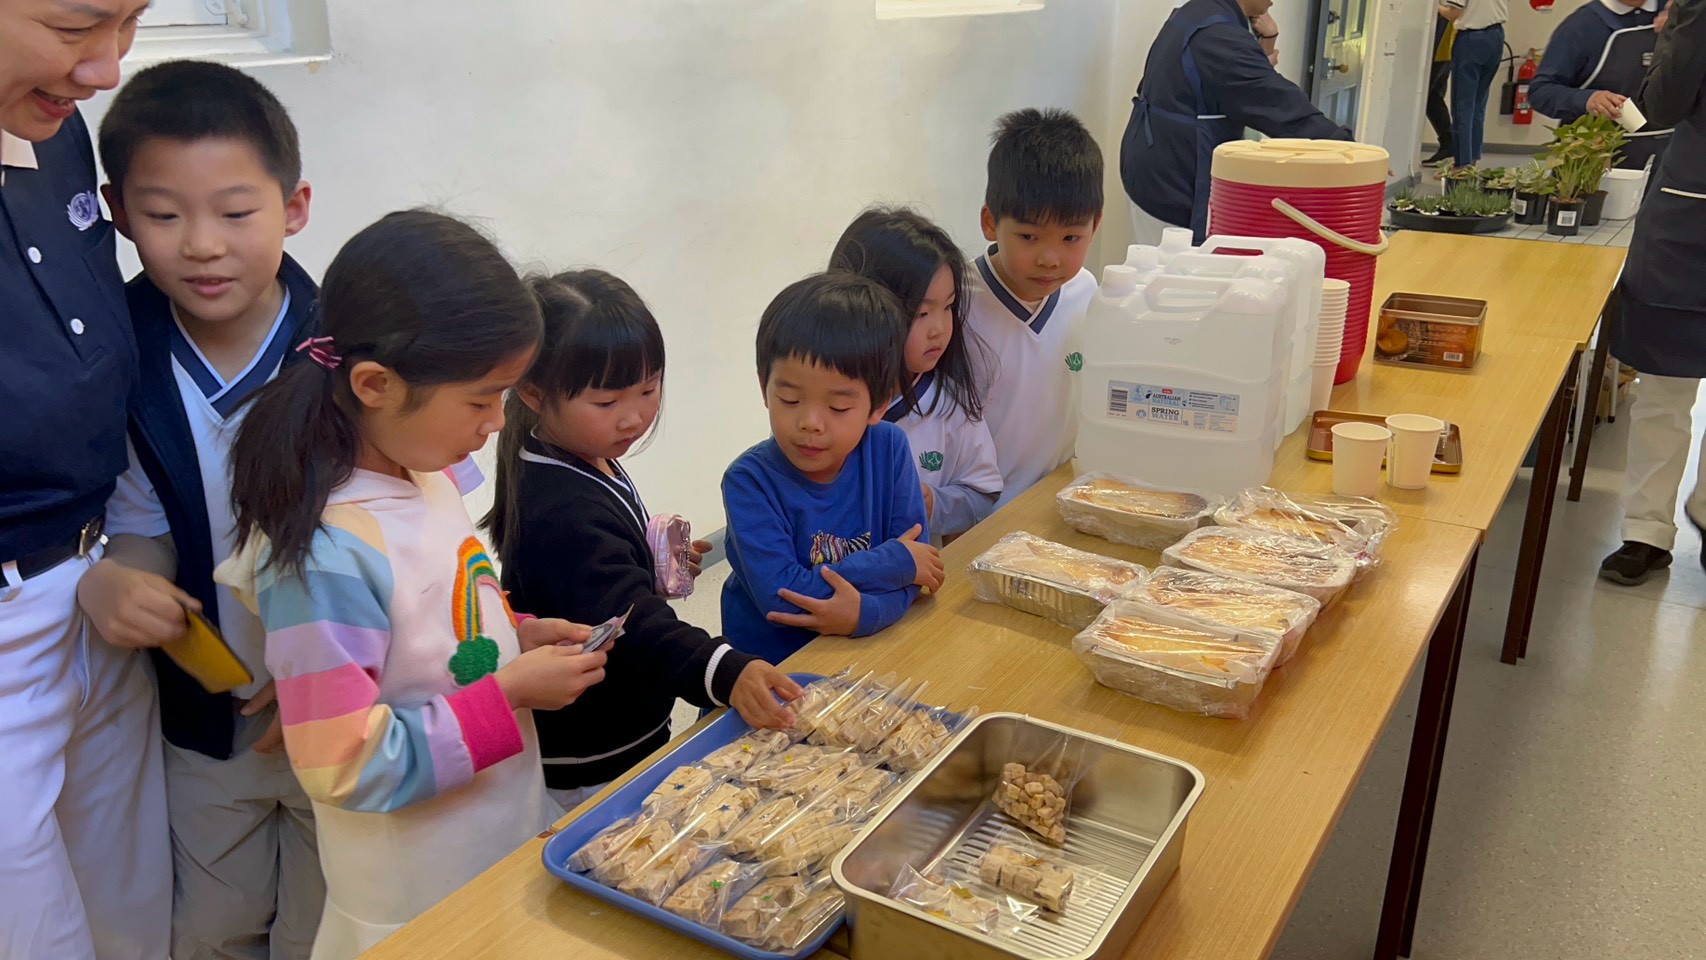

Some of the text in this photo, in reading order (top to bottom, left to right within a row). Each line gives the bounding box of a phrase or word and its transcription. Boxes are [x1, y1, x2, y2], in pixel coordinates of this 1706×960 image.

[1152, 393, 1181, 401] AUSTRALIAN
[1152, 398, 1179, 406] NATURAL
[1151, 407, 1180, 416] SPRING
[1151, 413, 1179, 421] WATER
